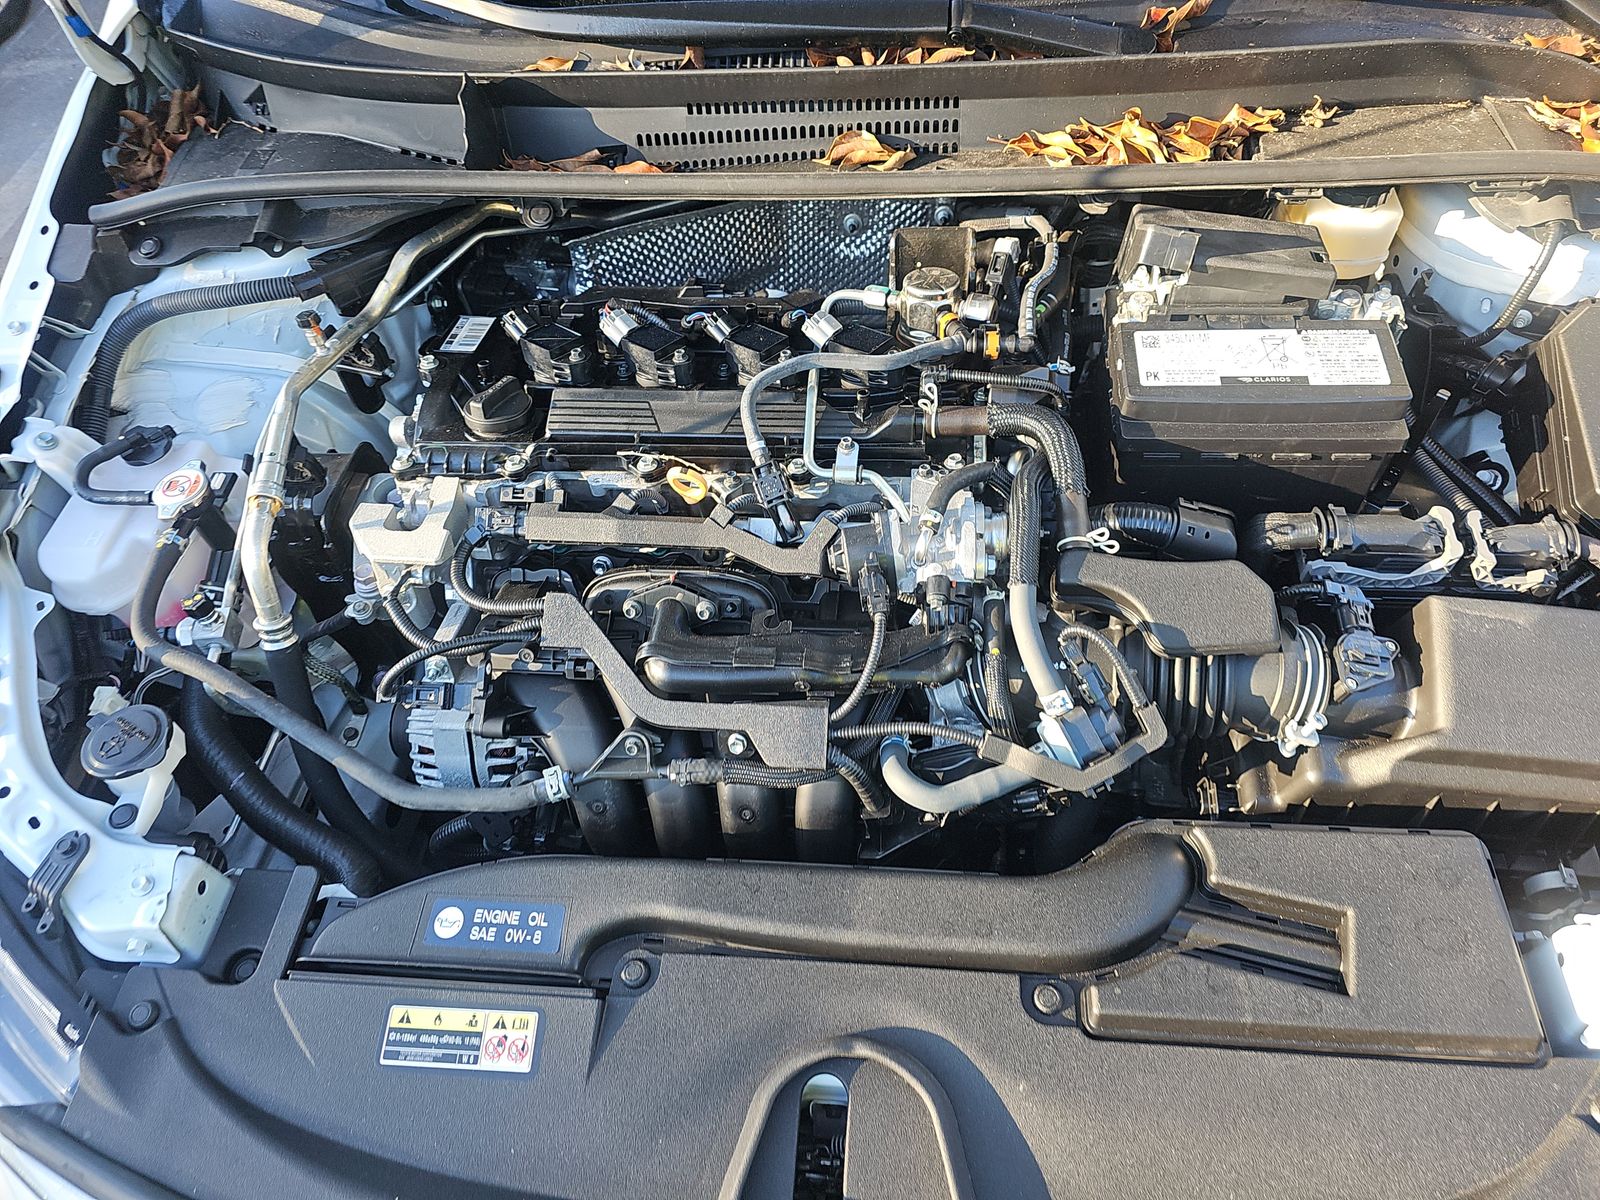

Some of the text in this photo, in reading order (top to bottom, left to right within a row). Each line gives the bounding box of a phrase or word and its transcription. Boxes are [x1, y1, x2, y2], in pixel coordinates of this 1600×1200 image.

[1145, 371, 1160, 381] PK
[473, 908, 548, 927] ENGINE OIL
[469, 926, 542, 945] SAE 0W-8
